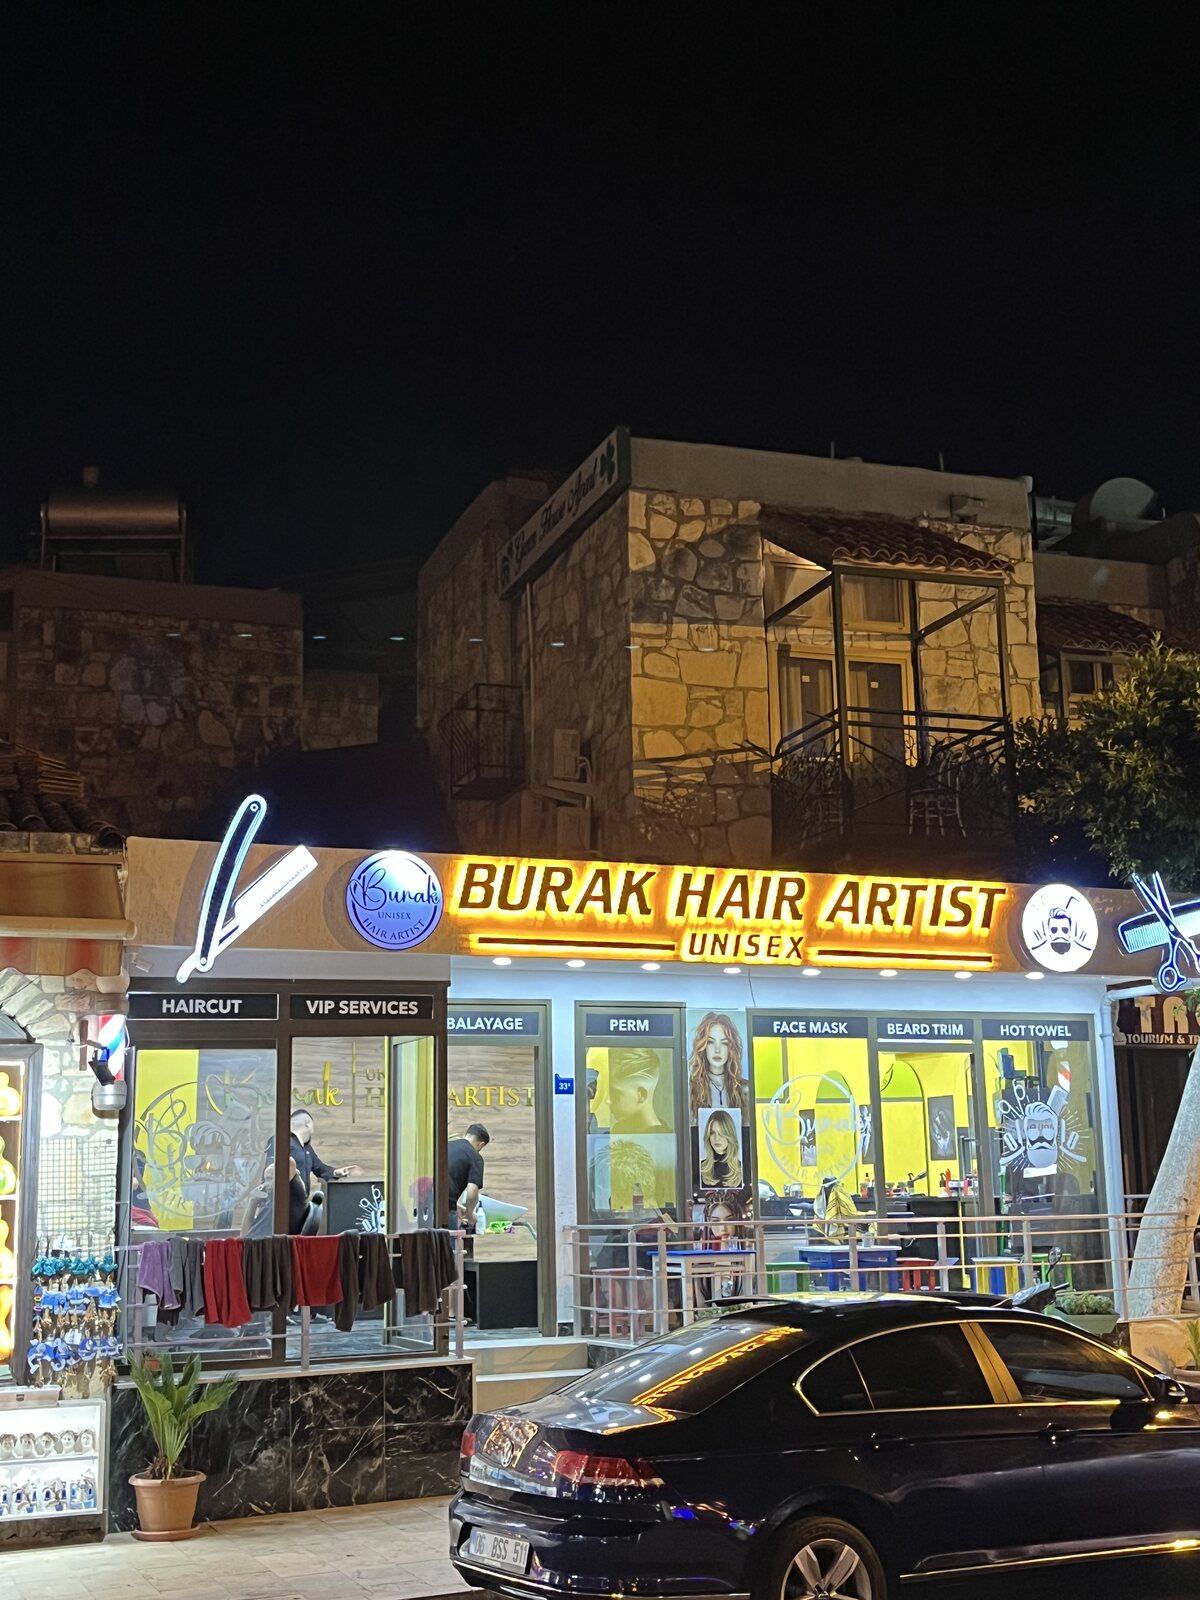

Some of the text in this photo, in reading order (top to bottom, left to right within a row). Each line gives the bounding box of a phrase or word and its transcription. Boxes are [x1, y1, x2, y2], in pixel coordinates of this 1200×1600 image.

[350, 867, 440, 911] Burak
[458, 862, 1006, 929] BURAK HAIR ARTIST
[378, 911, 412, 920] UNISEX
[363, 917, 425, 940] HAIR ARTIST
[689, 932, 804, 959] UNISEX
[162, 999, 243, 1014] HAIRCUT
[306, 1000, 418, 1015] VIP SERVICES
[447, 1017, 523, 1031] BALAYAGE
[609, 1018, 649, 1032] PERM
[773, 1021, 848, 1035] FACE MASK
[887, 1023, 964, 1036] BEARD TRIM
[1000, 1024, 1071, 1037] HOT TOWEL
[1126, 1034, 1173, 1044] TOURISM
[1177, 1035, 1186, 1044] &
[447, 1086, 535, 1107] ARTIST
[491, 1537, 509, 1560] BSS
[513, 1542, 528, 1565] 511
